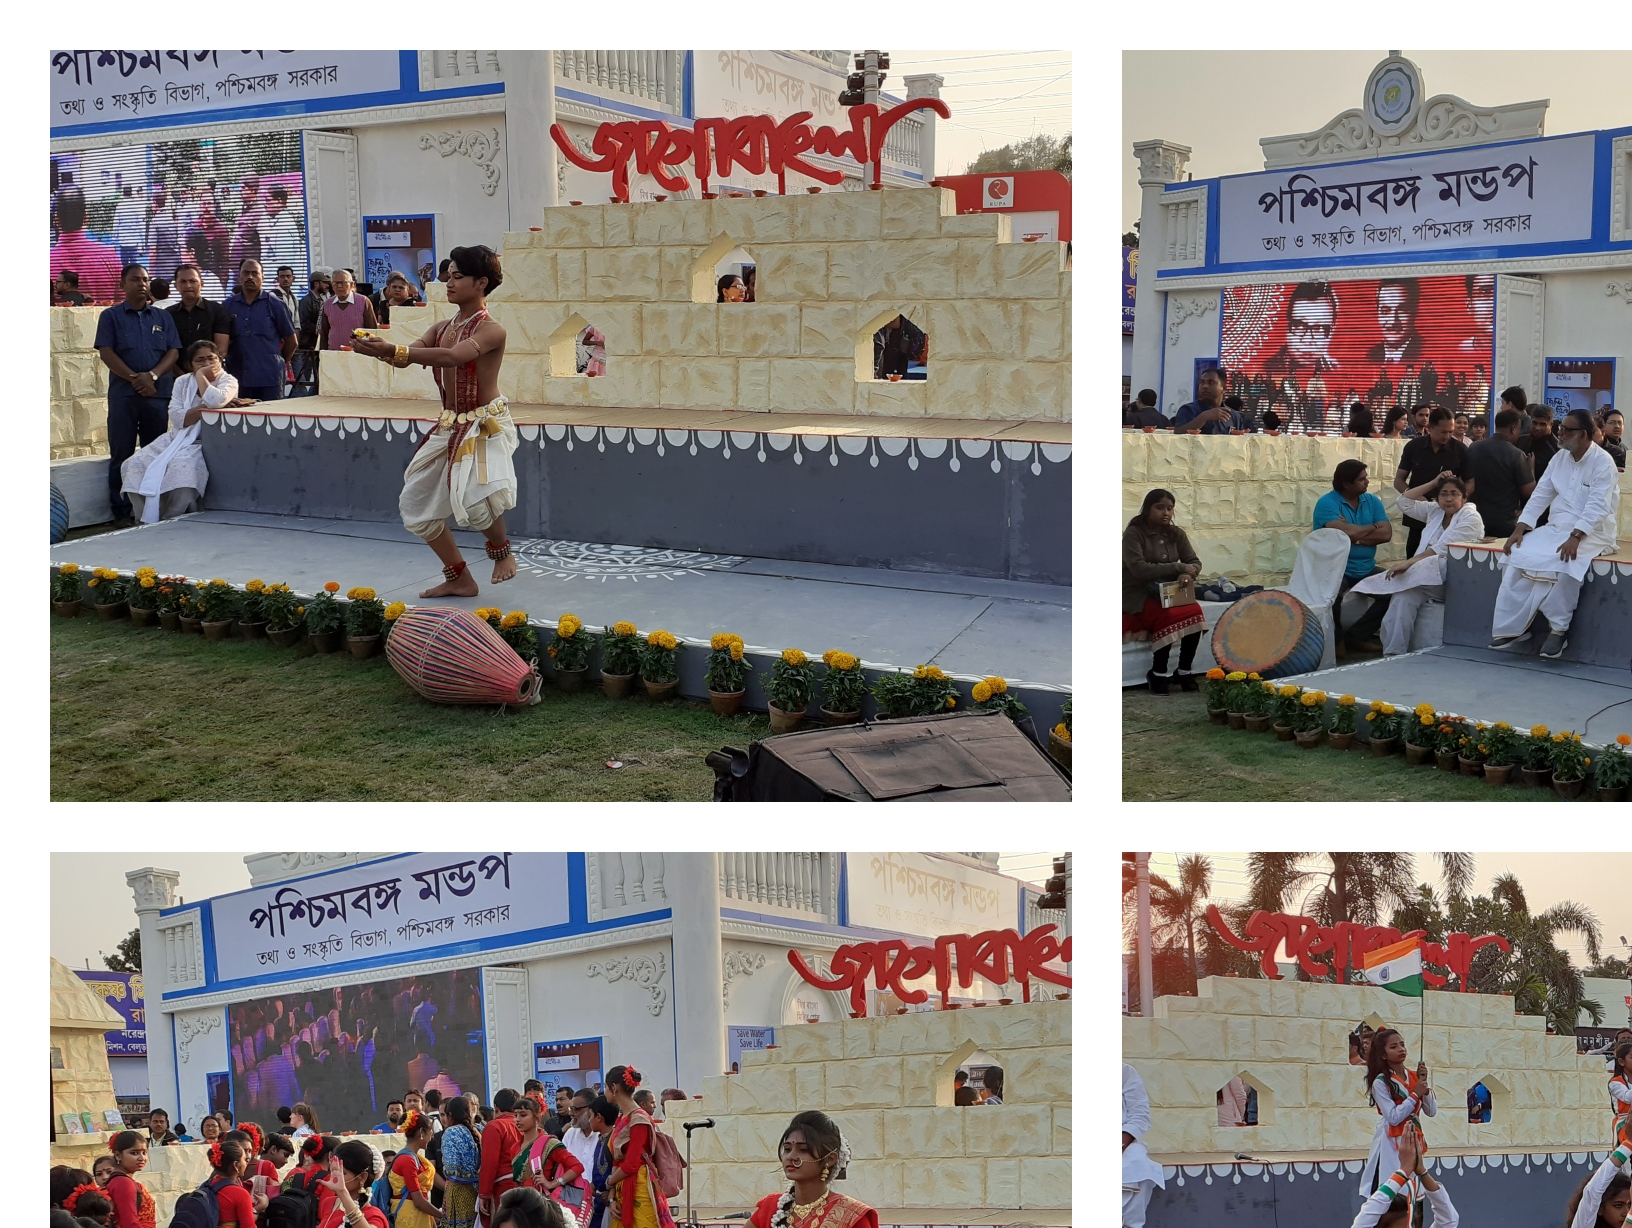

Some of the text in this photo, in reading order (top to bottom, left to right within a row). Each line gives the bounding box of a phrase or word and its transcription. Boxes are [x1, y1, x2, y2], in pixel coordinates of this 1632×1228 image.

[55, 64, 338, 117] তথ্য ও সংস্কৃতি বিভাগ, পশ্চিমবঙ্গ সরকার
[1258, 173, 1422, 224] পশ্চিমবঙ্গ
[1262, 214, 1532, 253] তথ্য ও সংস্কৃতি বিভাগ, পশ্চিমবঙ্গ সরকার
[250, 878, 402, 938] পশ্চিমবঙ্গ
[256, 904, 511, 965] তথ্য ও সংস্কৃতি বিভাগ, পশ্চিমবঙ্গ সরকার
[737, 1029, 765, 1038] Save Water
[740, 1038, 763, 1048] Save Life
